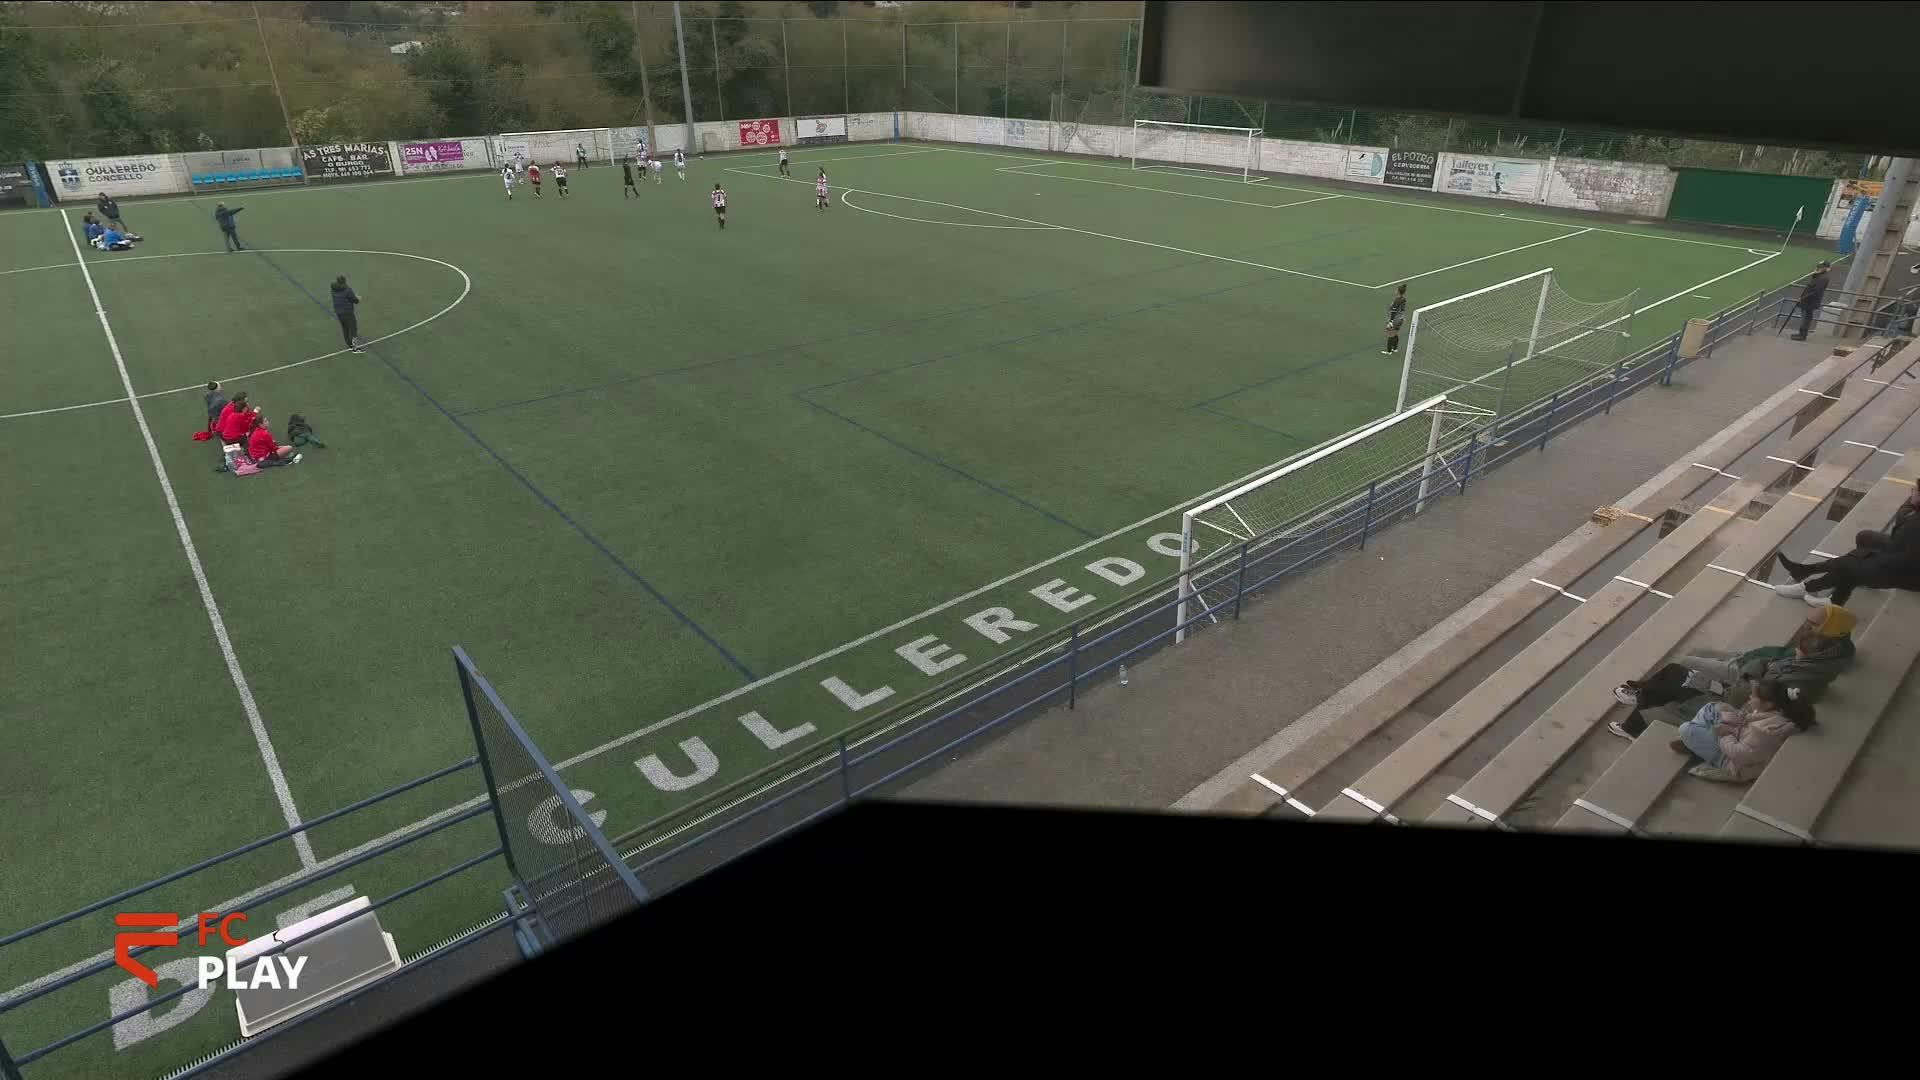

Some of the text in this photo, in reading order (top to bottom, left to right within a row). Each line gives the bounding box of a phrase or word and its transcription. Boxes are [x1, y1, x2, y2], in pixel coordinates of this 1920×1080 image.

[303, 143, 384, 161] AS TRES MARIAS
[405, 147, 424, 155] 25N
[1391, 153, 1434, 165] EL POTRO
[88, 173, 142, 182] CONCELLO
[527, 531, 1200, 846] CULLEREDO
